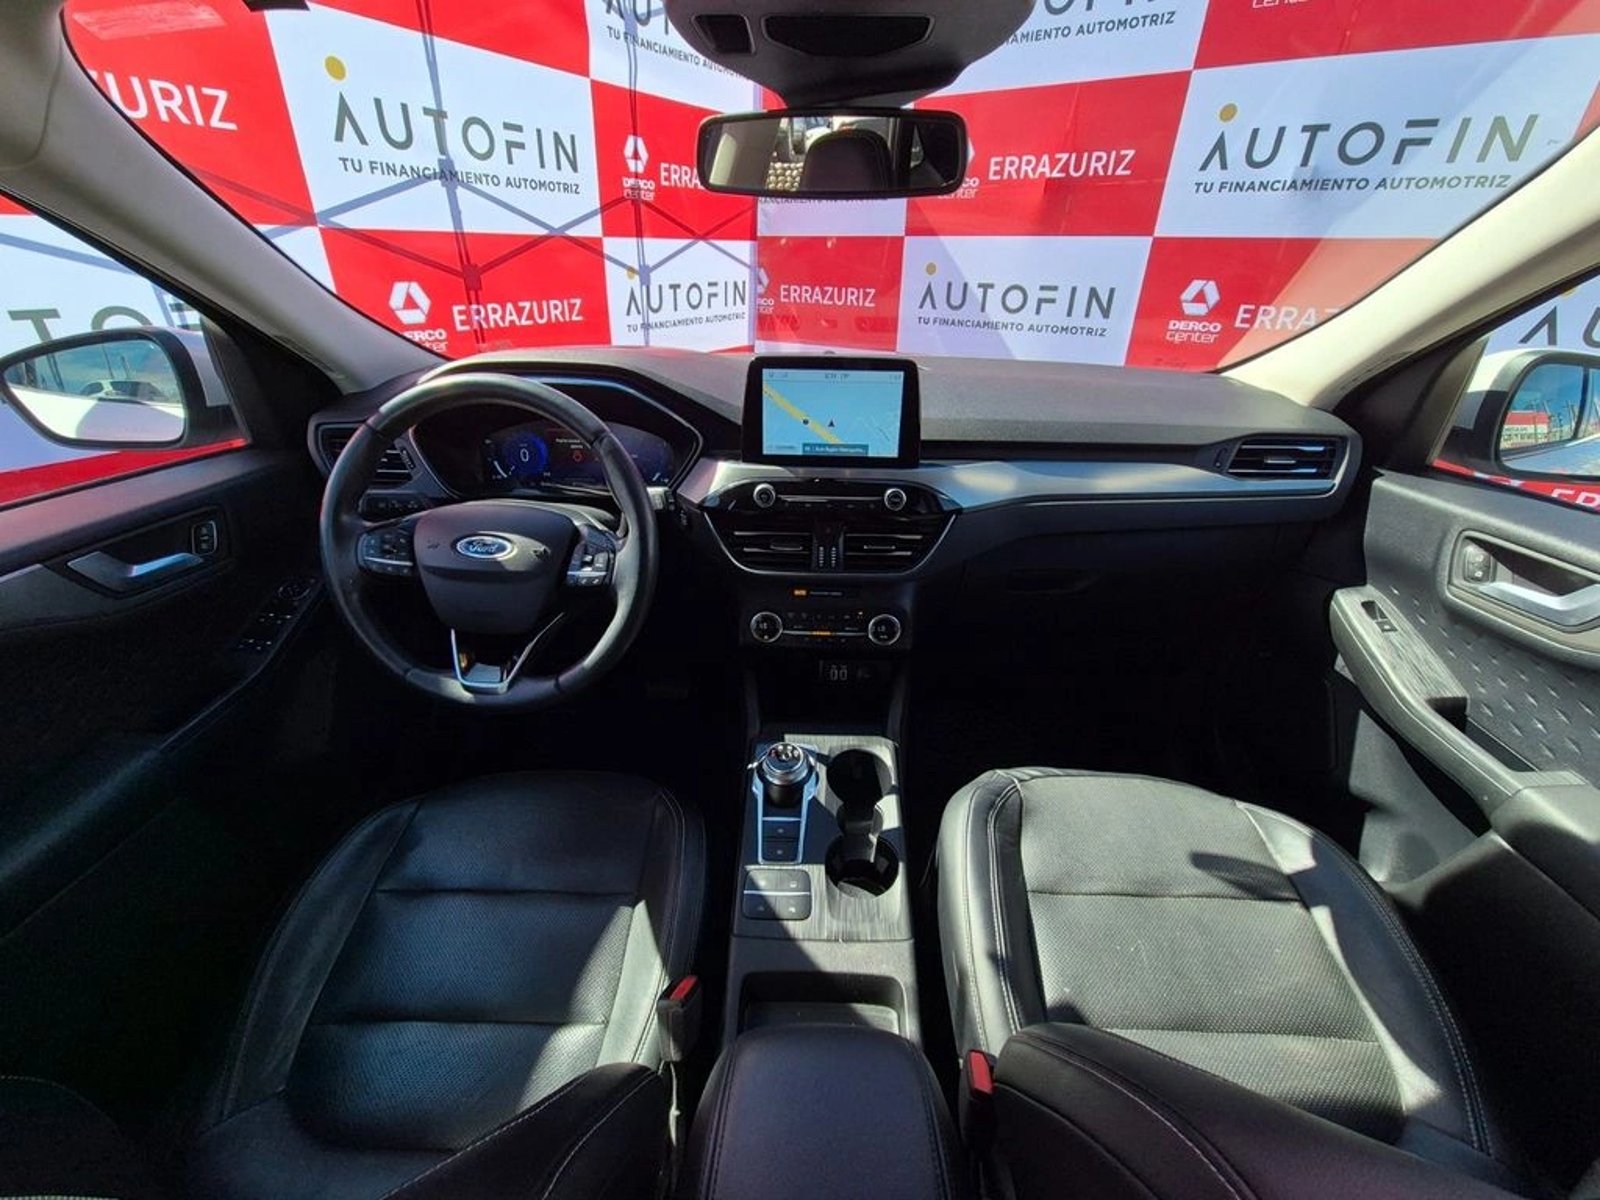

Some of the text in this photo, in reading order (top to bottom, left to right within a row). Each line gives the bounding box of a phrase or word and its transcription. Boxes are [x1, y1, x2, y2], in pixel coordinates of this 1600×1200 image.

[606, 26, 621, 40] TU
[1075, 11, 1176, 36] AUTOMOTRIZ
[89, 70, 237, 130] URIZ
[334, 92, 579, 173] AUTOFIN
[1199, 114, 1538, 171] AUTOFIN
[338, 156, 581, 195] TU FINANCIAMIENTO AUTOMOTRIZ
[988, 149, 1136, 180] ERRAZURIZ
[1194, 174, 1511, 194] TU FINANCIAMIENTO AUTOMOTRIZ
[626, 280, 746, 316] AUTOFIN
[780, 284, 876, 308] ERRAZURIZ
[918, 281, 1116, 319] AUTOFIN
[452, 298, 583, 332] ERRAZURIZ
[918, 316, 1108, 337] TU FINANCIAMIENTO AUTOMOTRIZ
[1168, 320, 1222, 332] DERCO
[1234, 304, 1340, 330] ERRA
[1166, 331, 1219, 343] center
